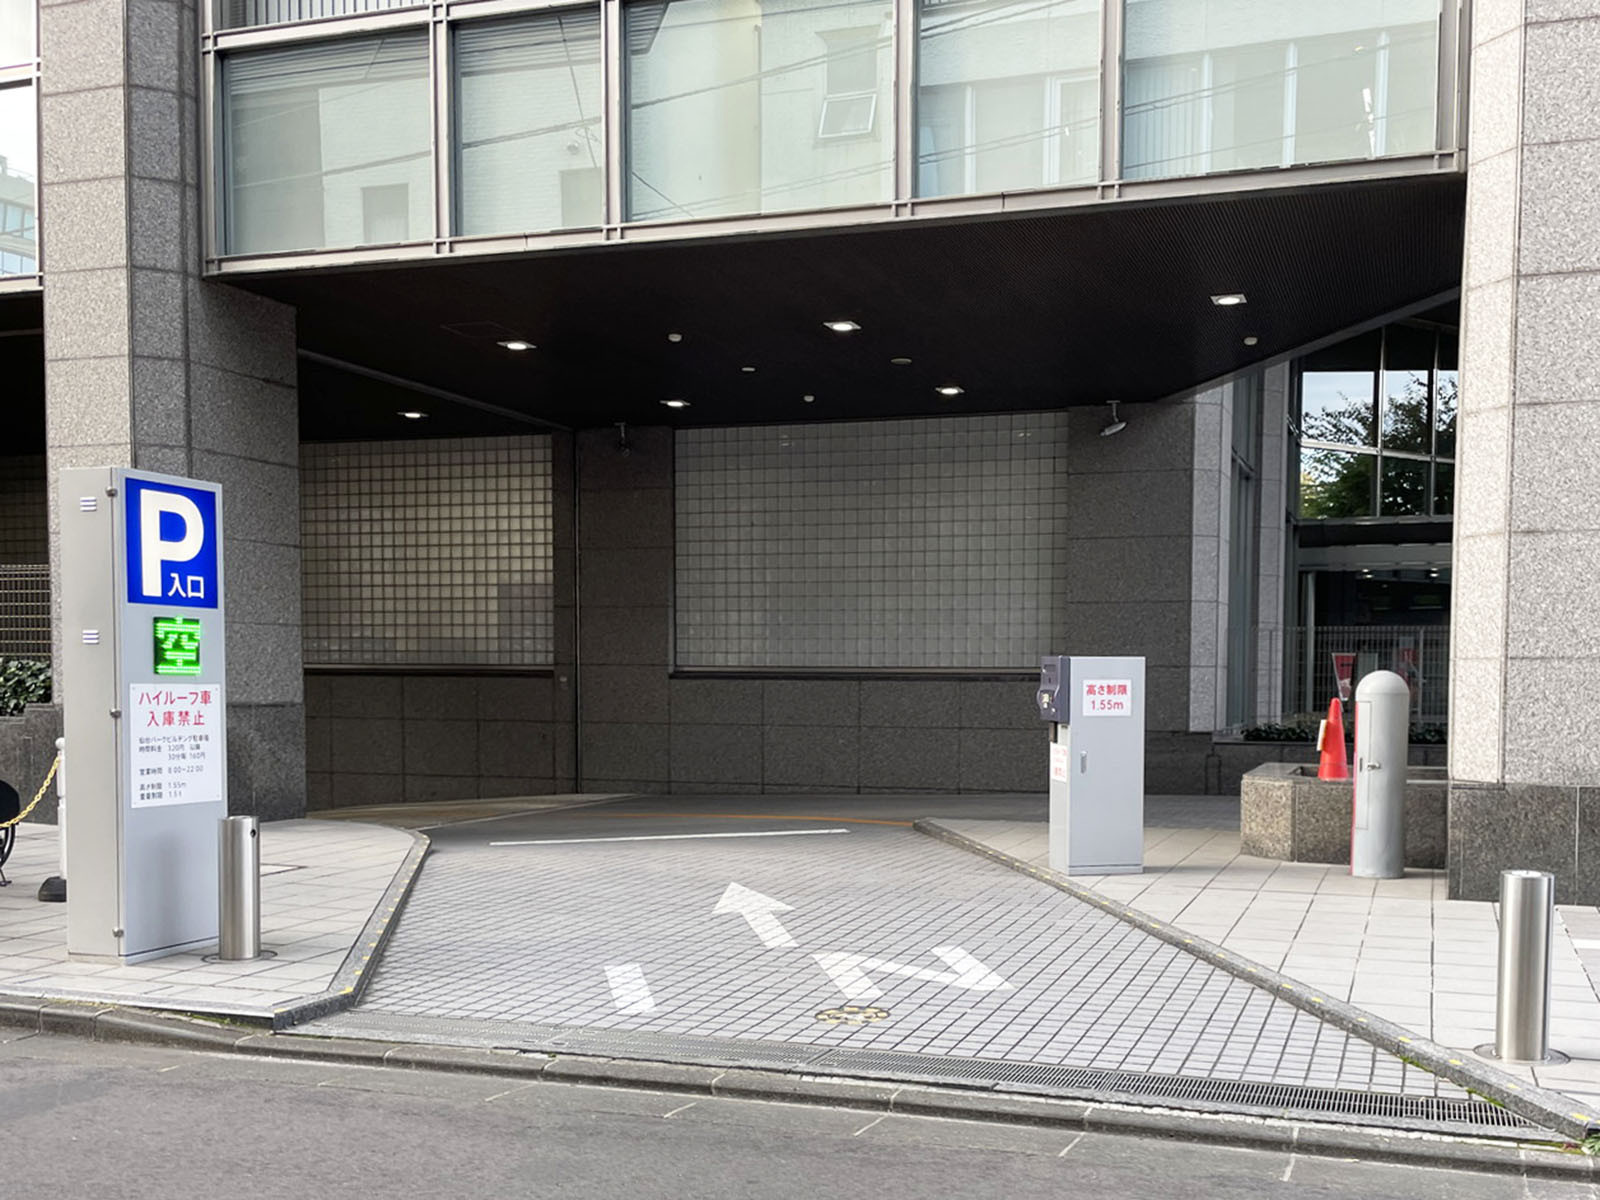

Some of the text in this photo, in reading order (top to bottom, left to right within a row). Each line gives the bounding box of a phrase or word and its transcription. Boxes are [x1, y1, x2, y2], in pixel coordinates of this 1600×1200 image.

[140, 489, 204, 597] P
[168, 573, 205, 599] 入口
[155, 614, 201, 674] 空
[139, 690, 211, 706] ハイルーフ車
[1086, 685, 1127, 696] 高さ制限
[1091, 699, 1124, 711] 1.55m
[147, 710, 206, 727] 入庫禁止
